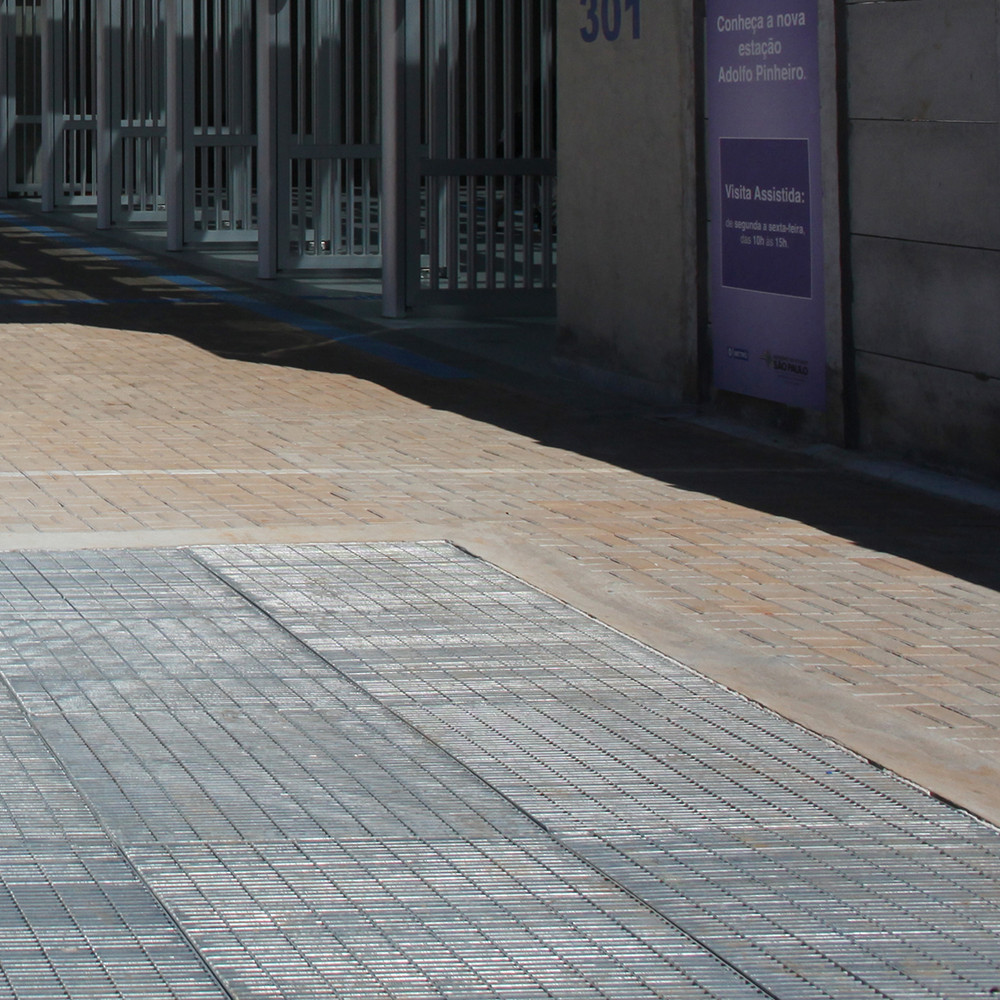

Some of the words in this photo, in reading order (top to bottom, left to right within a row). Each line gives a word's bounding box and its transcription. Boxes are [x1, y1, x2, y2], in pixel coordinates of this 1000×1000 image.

[717, 14, 763, 35] Conheça
[767, 15, 773, 28] a
[777, 12, 805, 27] nova
[738, 37, 782, 60] estação
[718, 65, 752, 82] Adolfo
[756, 62, 806, 81] Pinheiro.
[725, 184, 751, 200] Visita
[754, 186, 805, 203] Assistida:
[725, 219, 733, 228] de
[734, 220, 761, 231] segunda
